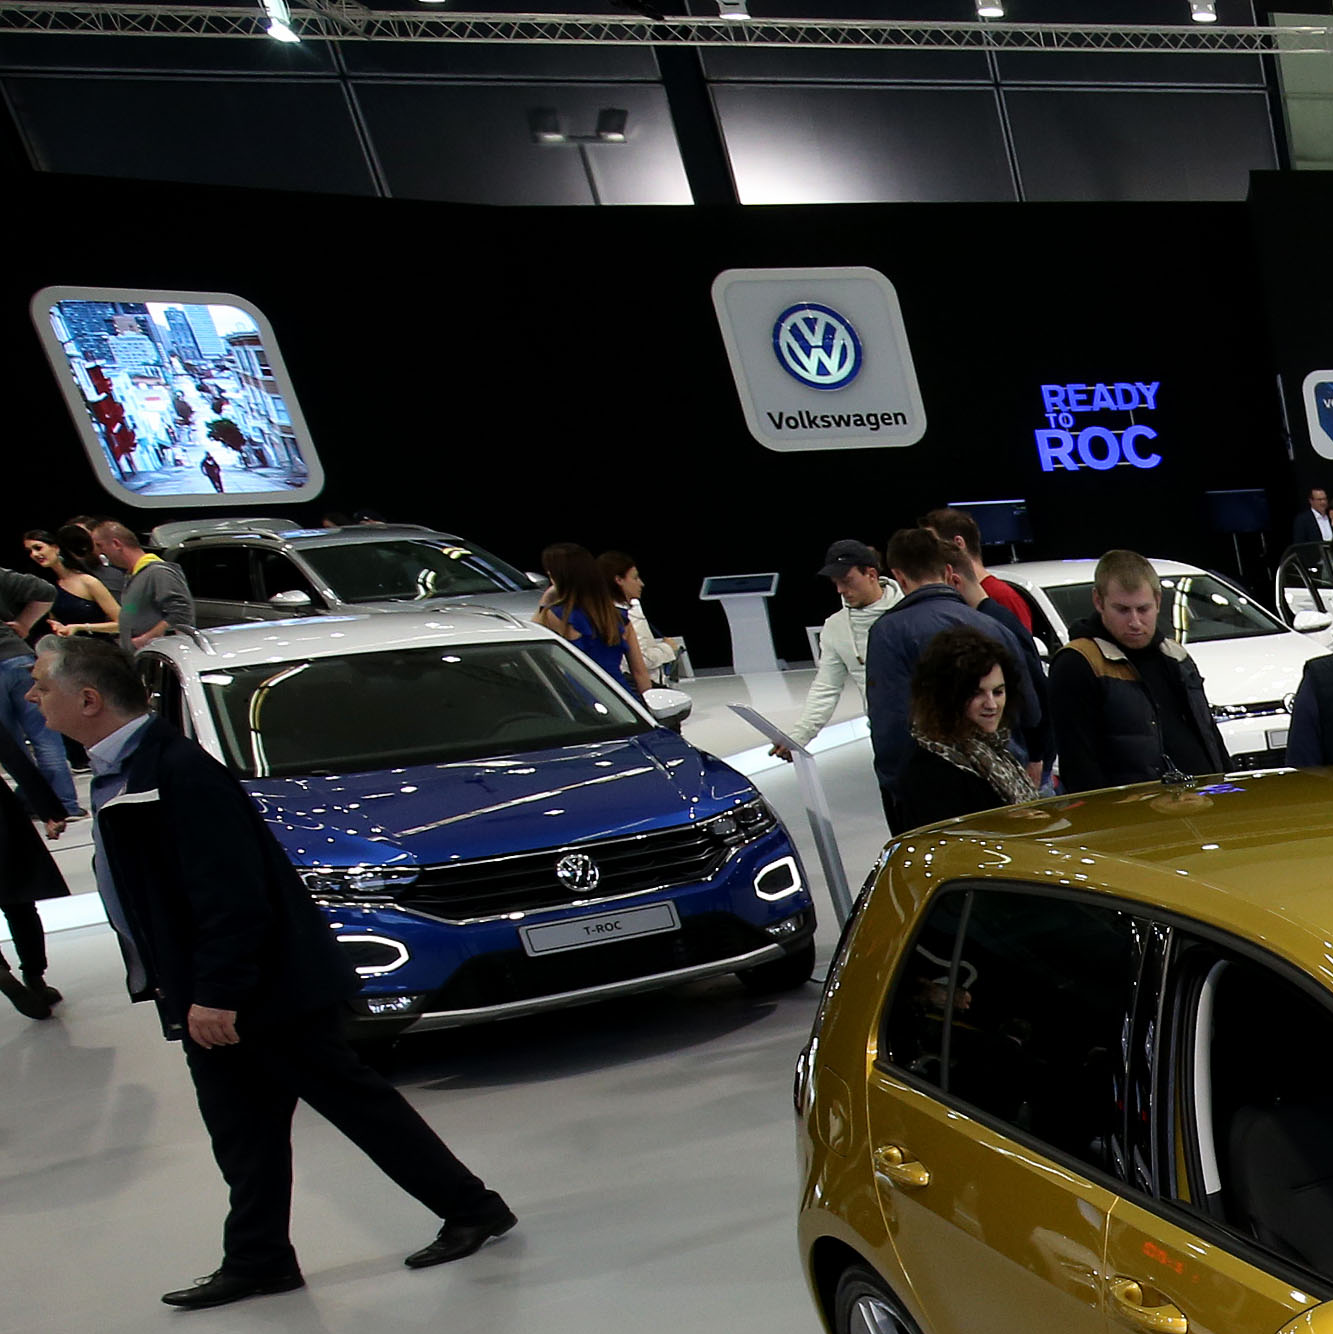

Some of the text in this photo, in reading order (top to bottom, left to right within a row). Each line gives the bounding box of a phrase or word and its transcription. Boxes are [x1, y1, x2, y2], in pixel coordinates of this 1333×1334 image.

[1041, 381, 1160, 412] READY
[767, 410, 908, 431] Volkswagen
[1044, 412, 1075, 428] TO
[1034, 424, 1162, 472] ROC
[584, 920, 623, 936] T-ROC
